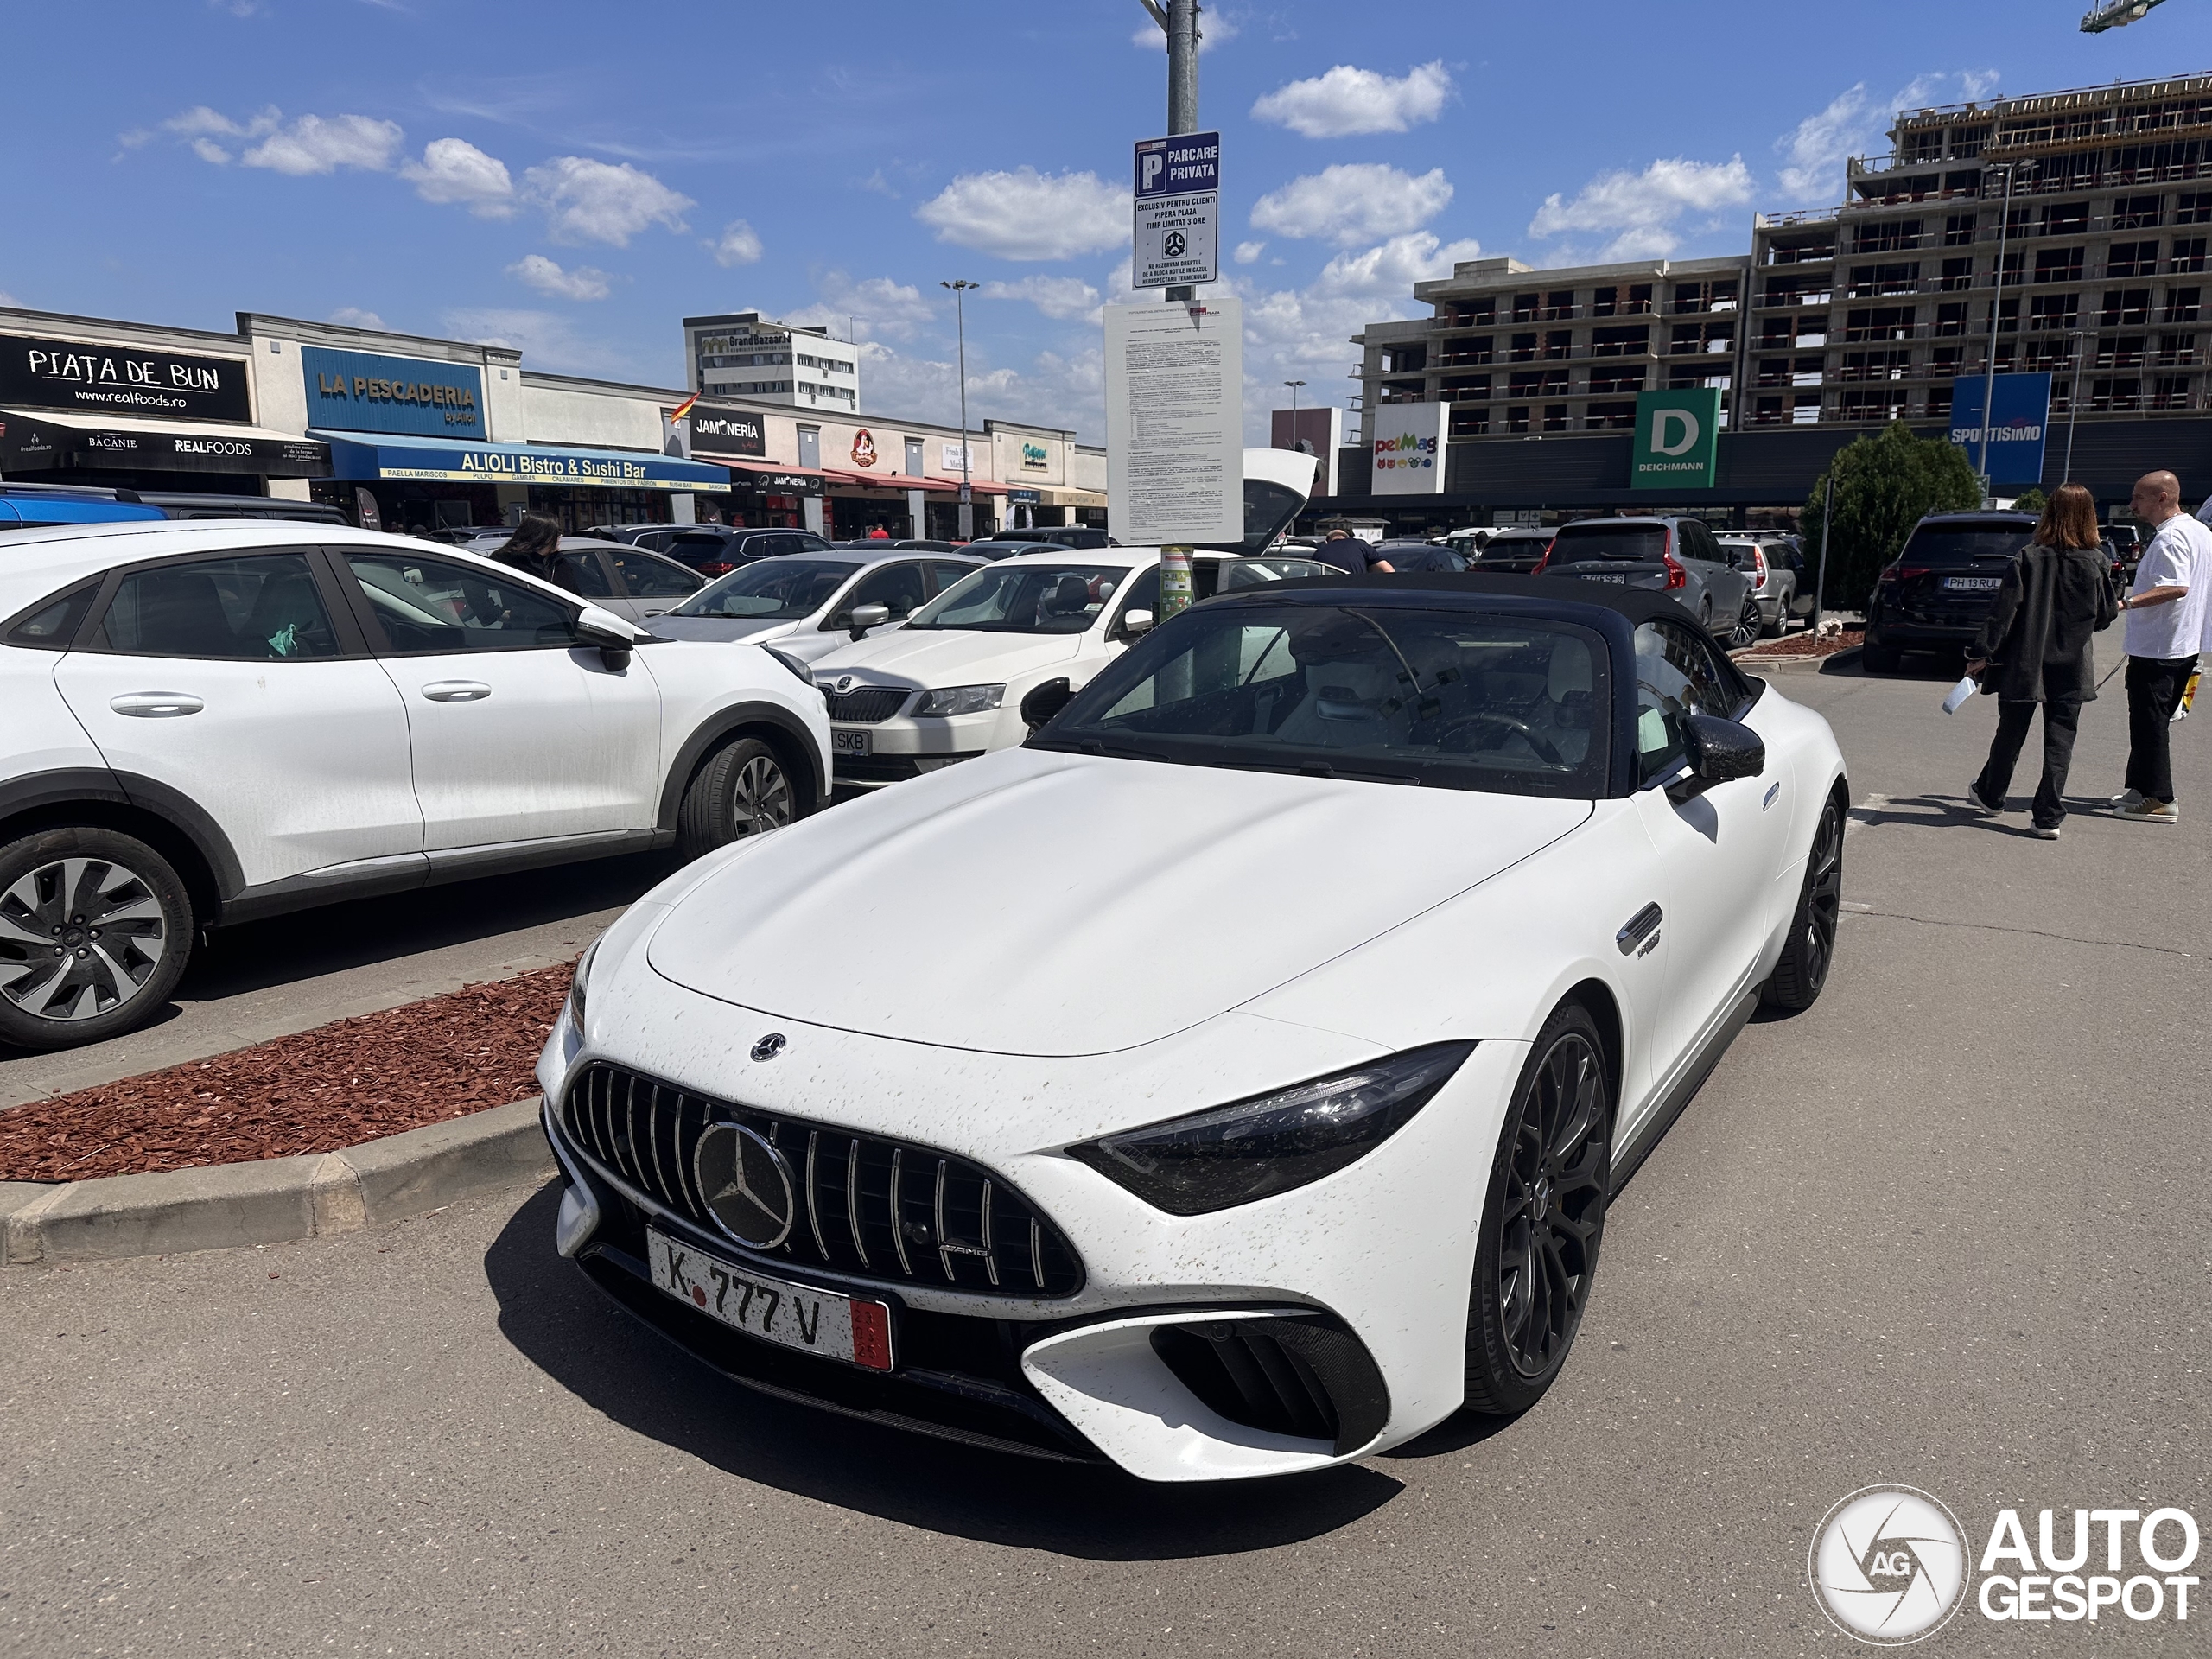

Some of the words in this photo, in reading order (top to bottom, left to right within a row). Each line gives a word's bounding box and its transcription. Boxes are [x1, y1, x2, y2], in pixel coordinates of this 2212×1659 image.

[1167, 145, 1217, 163] PARCARE
[1142, 154, 1163, 190] P
[1170, 163, 1215, 181] PRIVATA
[1137, 201, 1166, 212] EXCLUSIV
[1166, 199, 1191, 208] PENTRU
[1192, 196, 1216, 206] CLIENTI
[1154, 210, 1176, 219] PIPERA
[1178, 207, 1197, 217] PLAZA
[1147, 221, 1161, 230] TIMP
[1162, 219, 1185, 228] LIMITAT
[1178, 273, 1208, 282] TERMENULUI
[126, 360, 161, 385] DE
[169, 364, 219, 390] BUN
[318, 372, 347, 395] LA
[353, 376, 474, 406] PESCADERIA
[75, 391, 187, 408] www.realfoods.ro
[444, 412, 456, 423] by
[1650, 409, 1700, 456] D
[88, 435, 137, 448] BĂCĂNIE
[175, 439, 252, 456] REALFOODS
[1374, 432, 1437, 455] petMag
[945, 446, 959, 456] Fresh
[461, 453, 516, 473] ALIOLI
[520, 455, 564, 475] Bistro
[568, 458, 578, 475] &
[582, 459, 620, 477] Sushi
[623, 462, 646, 479] Bar
[1638, 462, 1704, 472] DEICHMANN
[1949, 578, 1965, 588] PH
[1968, 578, 1978, 588] 13
[1979, 578, 2000, 588] RUL
[837, 732, 864, 750] SKB
[953, 1246, 988, 1257] AMG
[667, 1243, 690, 1297] K
[710, 1266, 780, 1333] 777
[793, 1296, 820, 1345] V
[1483, 1280, 1503, 1384] MICHELIN
